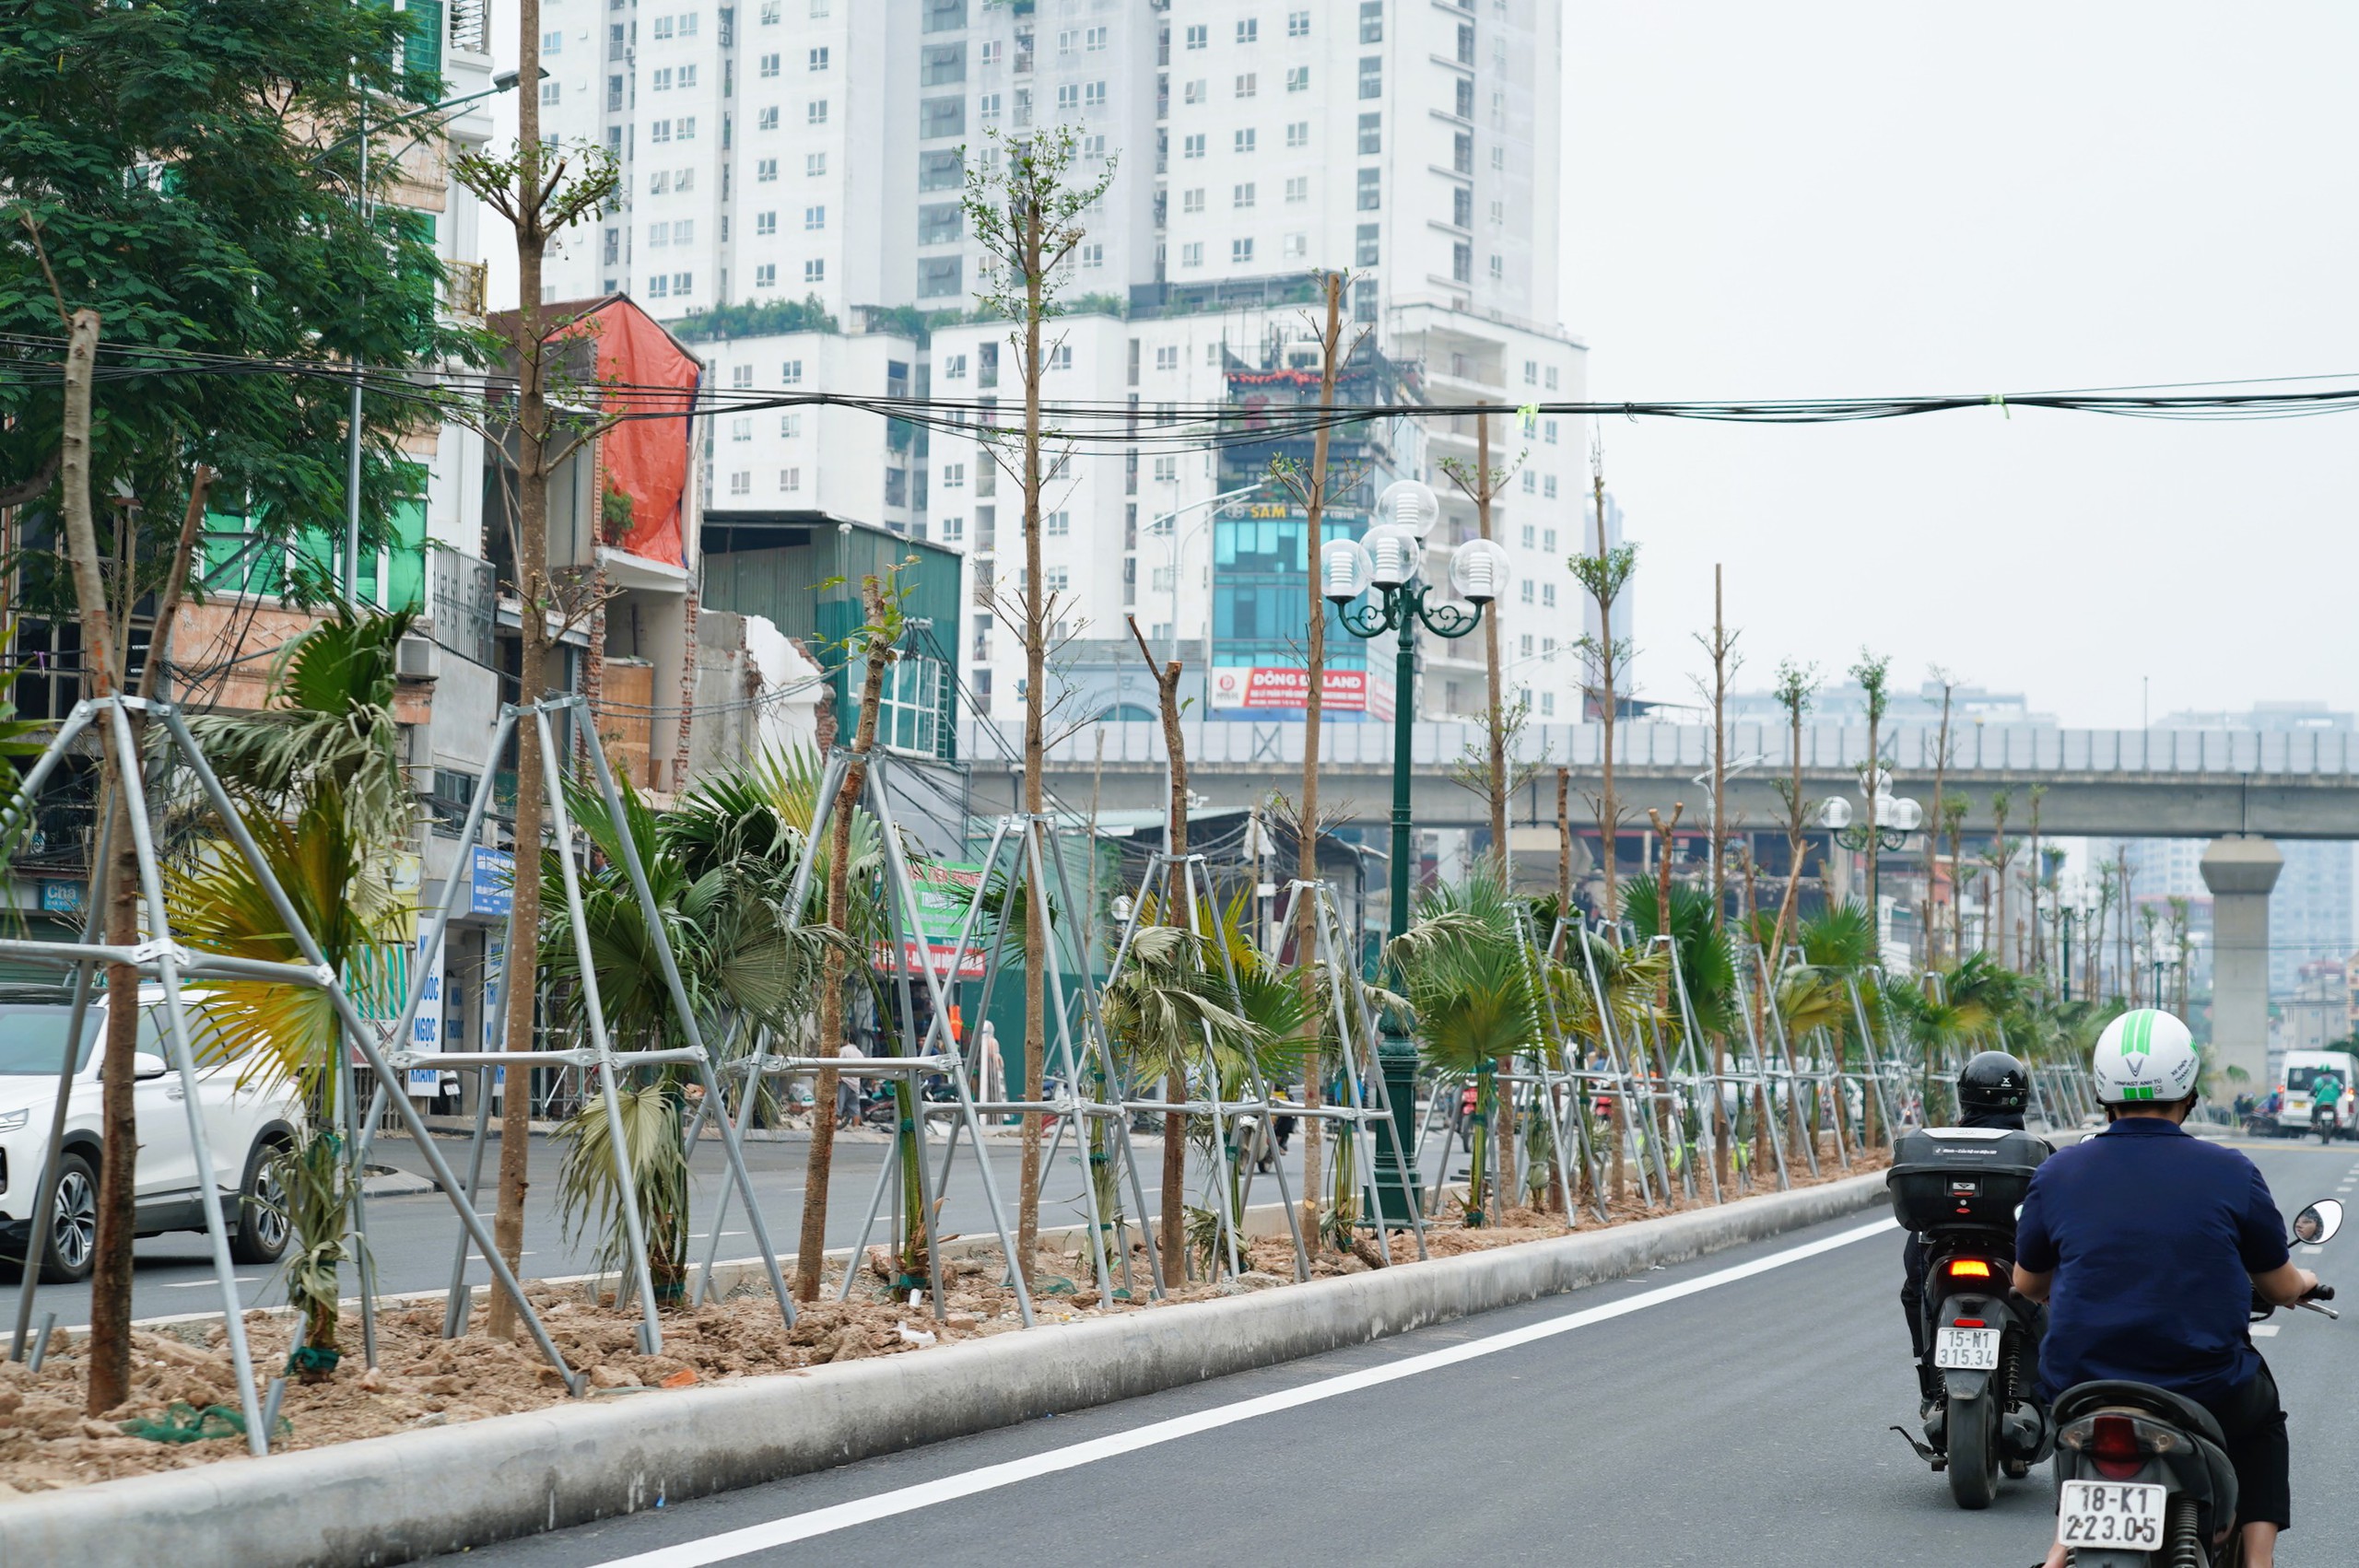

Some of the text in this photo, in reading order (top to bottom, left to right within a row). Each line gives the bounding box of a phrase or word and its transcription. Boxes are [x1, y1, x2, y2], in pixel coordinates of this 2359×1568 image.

[1250, 506, 1286, 519] SAM
[1253, 671, 1296, 686] ĐÔNG
[1323, 675, 1362, 689] LAND
[415, 1017, 436, 1047] NGỌC
[1949, 1331, 1989, 1348] 15-N1
[1940, 1348, 1993, 1366] 315.34
[2082, 1485, 2148, 1514] 18-K1
[2066, 1515, 2156, 1543] 223.05
